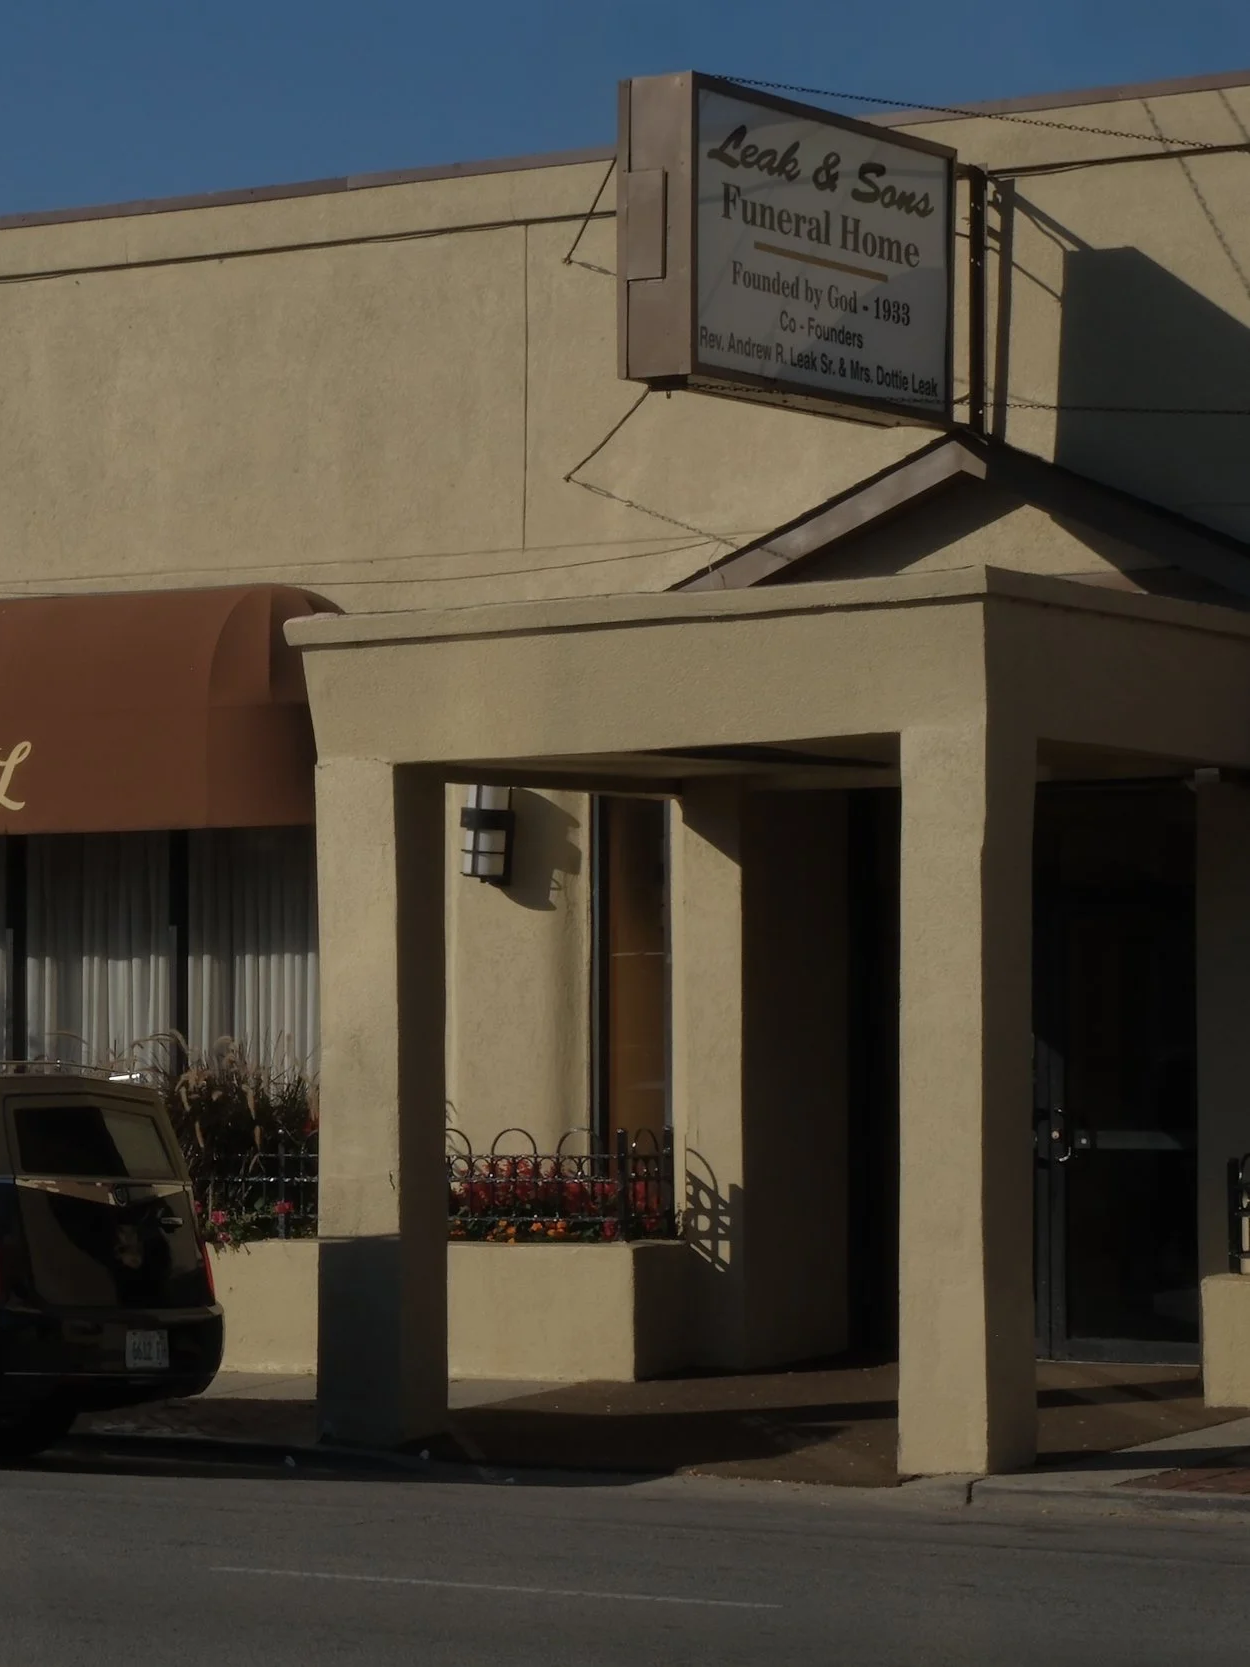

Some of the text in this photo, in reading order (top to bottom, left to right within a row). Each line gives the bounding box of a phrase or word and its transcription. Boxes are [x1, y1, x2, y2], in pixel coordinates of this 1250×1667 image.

[707, 124, 935, 218] Leak & Sons
[721, 182, 920, 268] Funeral Home
[732, 260, 799, 300] Founded
[805, 278, 823, 310] by
[827, 285, 857, 314] God
[874, 296, 911, 327] 1933
[699, 326, 939, 397] Rev. Andrew R. Leak Sr. & Mrs. Dottie Leak
[779, 310, 796, 333] Co
[807, 317, 863, 349] Founders
